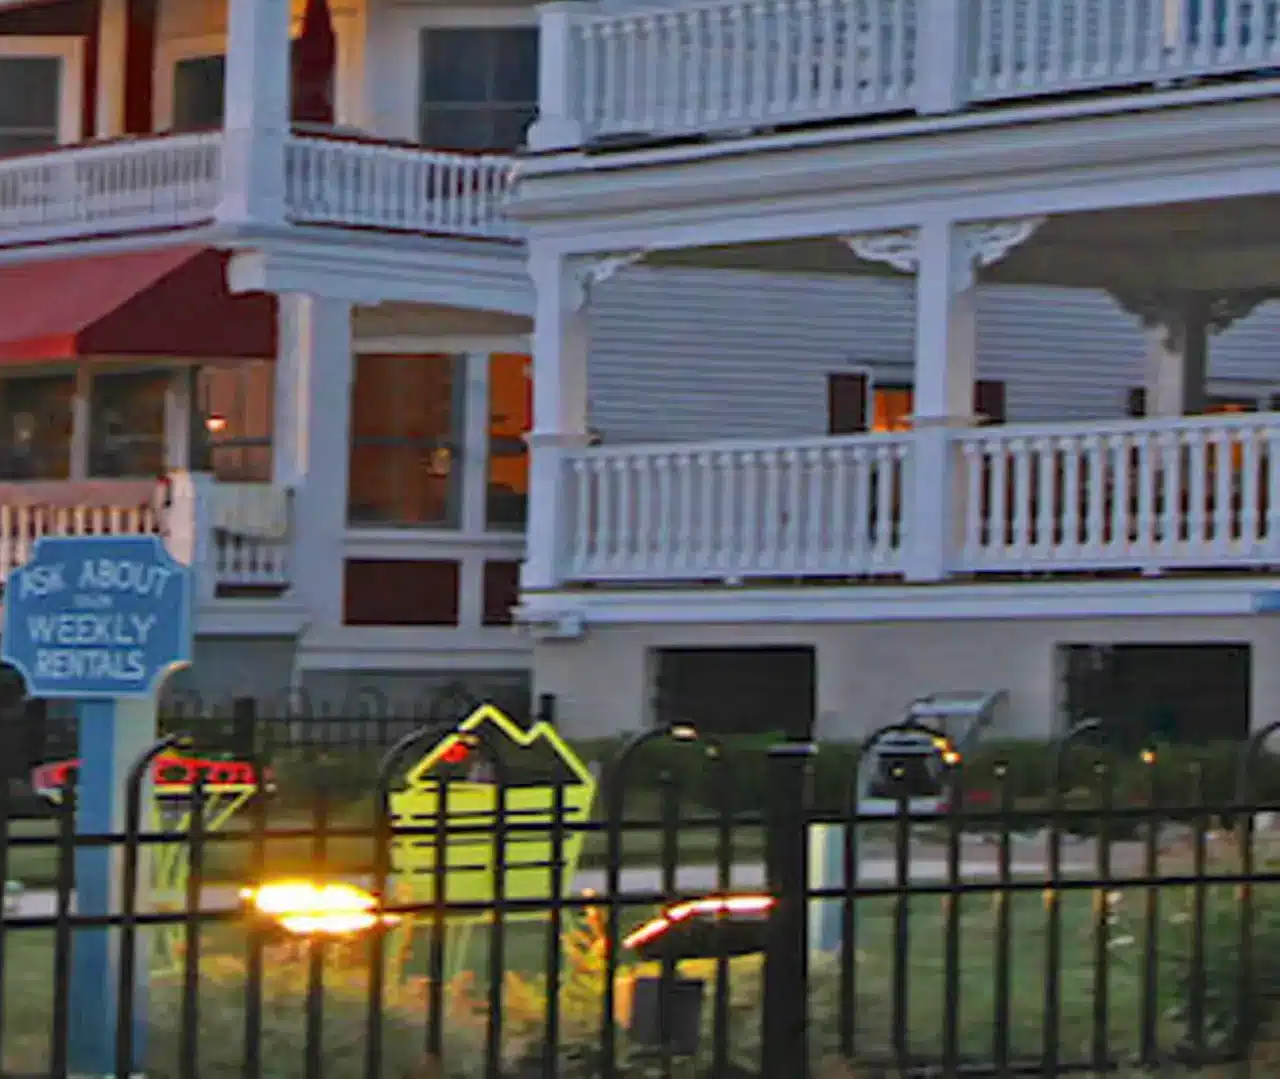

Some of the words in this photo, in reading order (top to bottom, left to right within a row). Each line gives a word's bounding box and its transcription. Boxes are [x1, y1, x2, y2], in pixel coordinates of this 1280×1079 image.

[78, 558, 172, 599] ABOUT
[26, 612, 156, 644] WEEKLY
[36, 648, 146, 681] RENTALS
